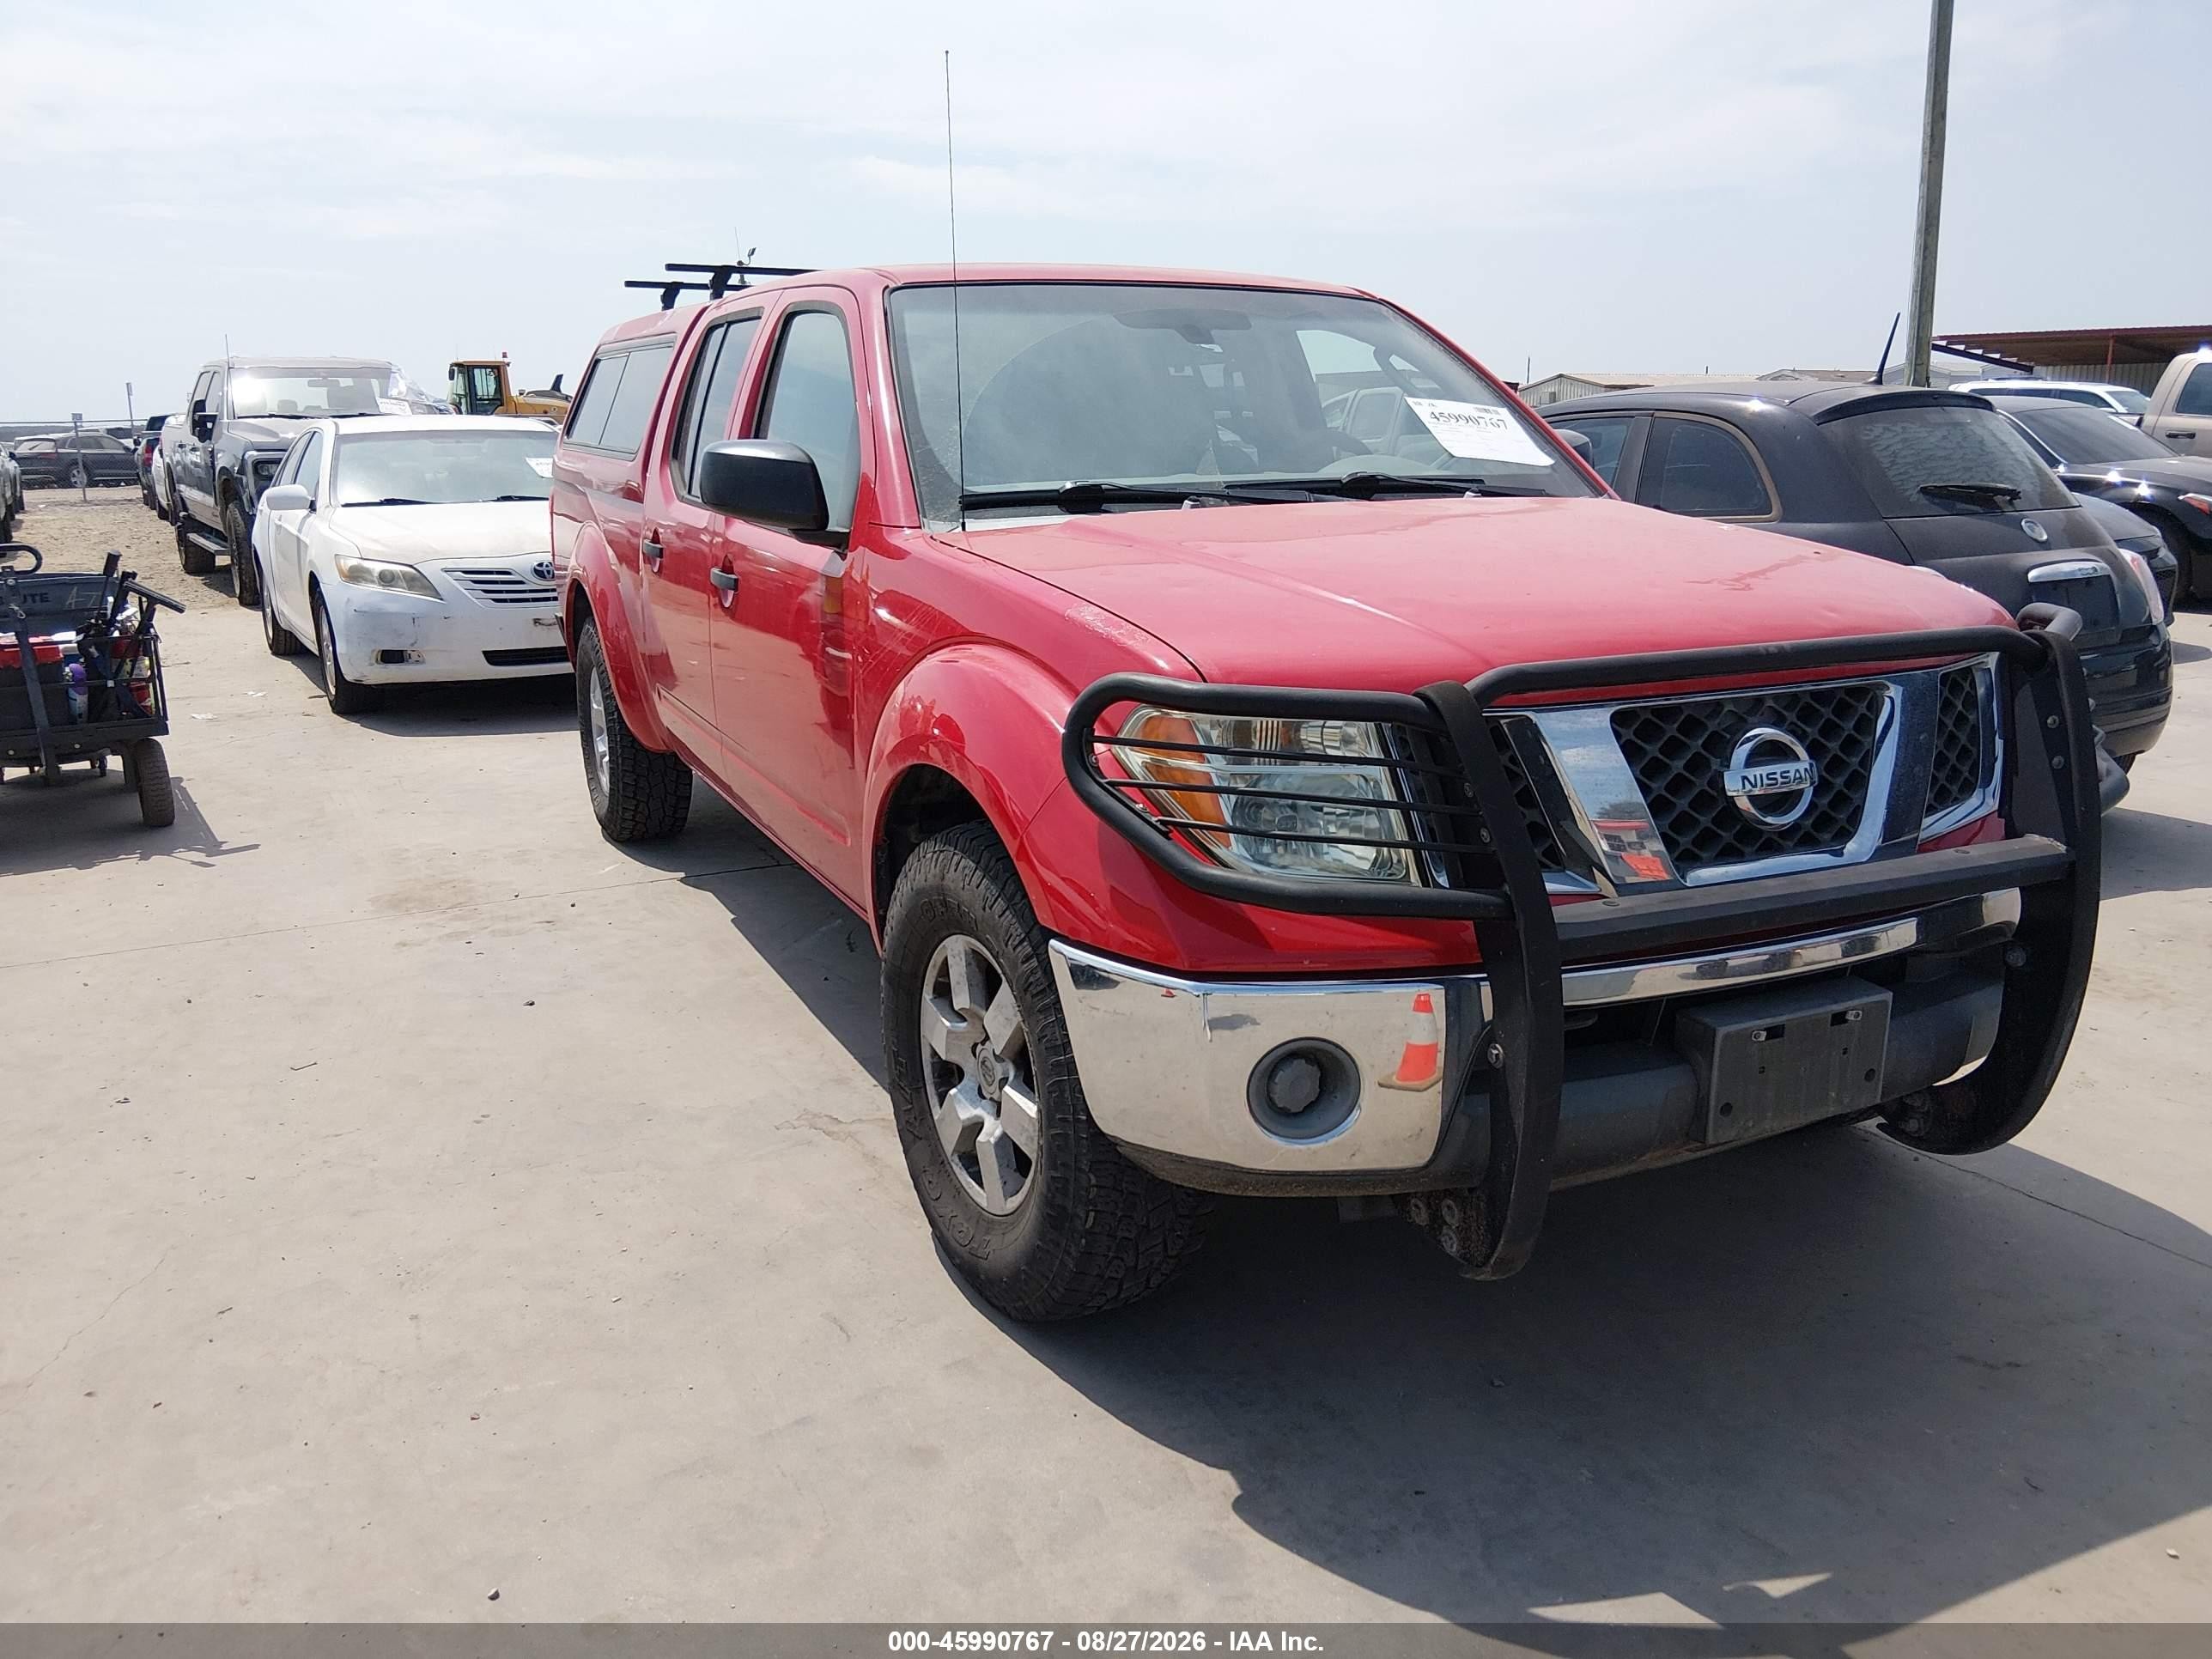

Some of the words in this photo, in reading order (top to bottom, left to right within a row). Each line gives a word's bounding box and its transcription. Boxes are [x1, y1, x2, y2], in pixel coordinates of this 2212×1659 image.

[1430, 411, 1509, 429] 45990767
[1741, 766, 1816, 789] NISSAN
[921, 1167, 991, 1261] TOYO
